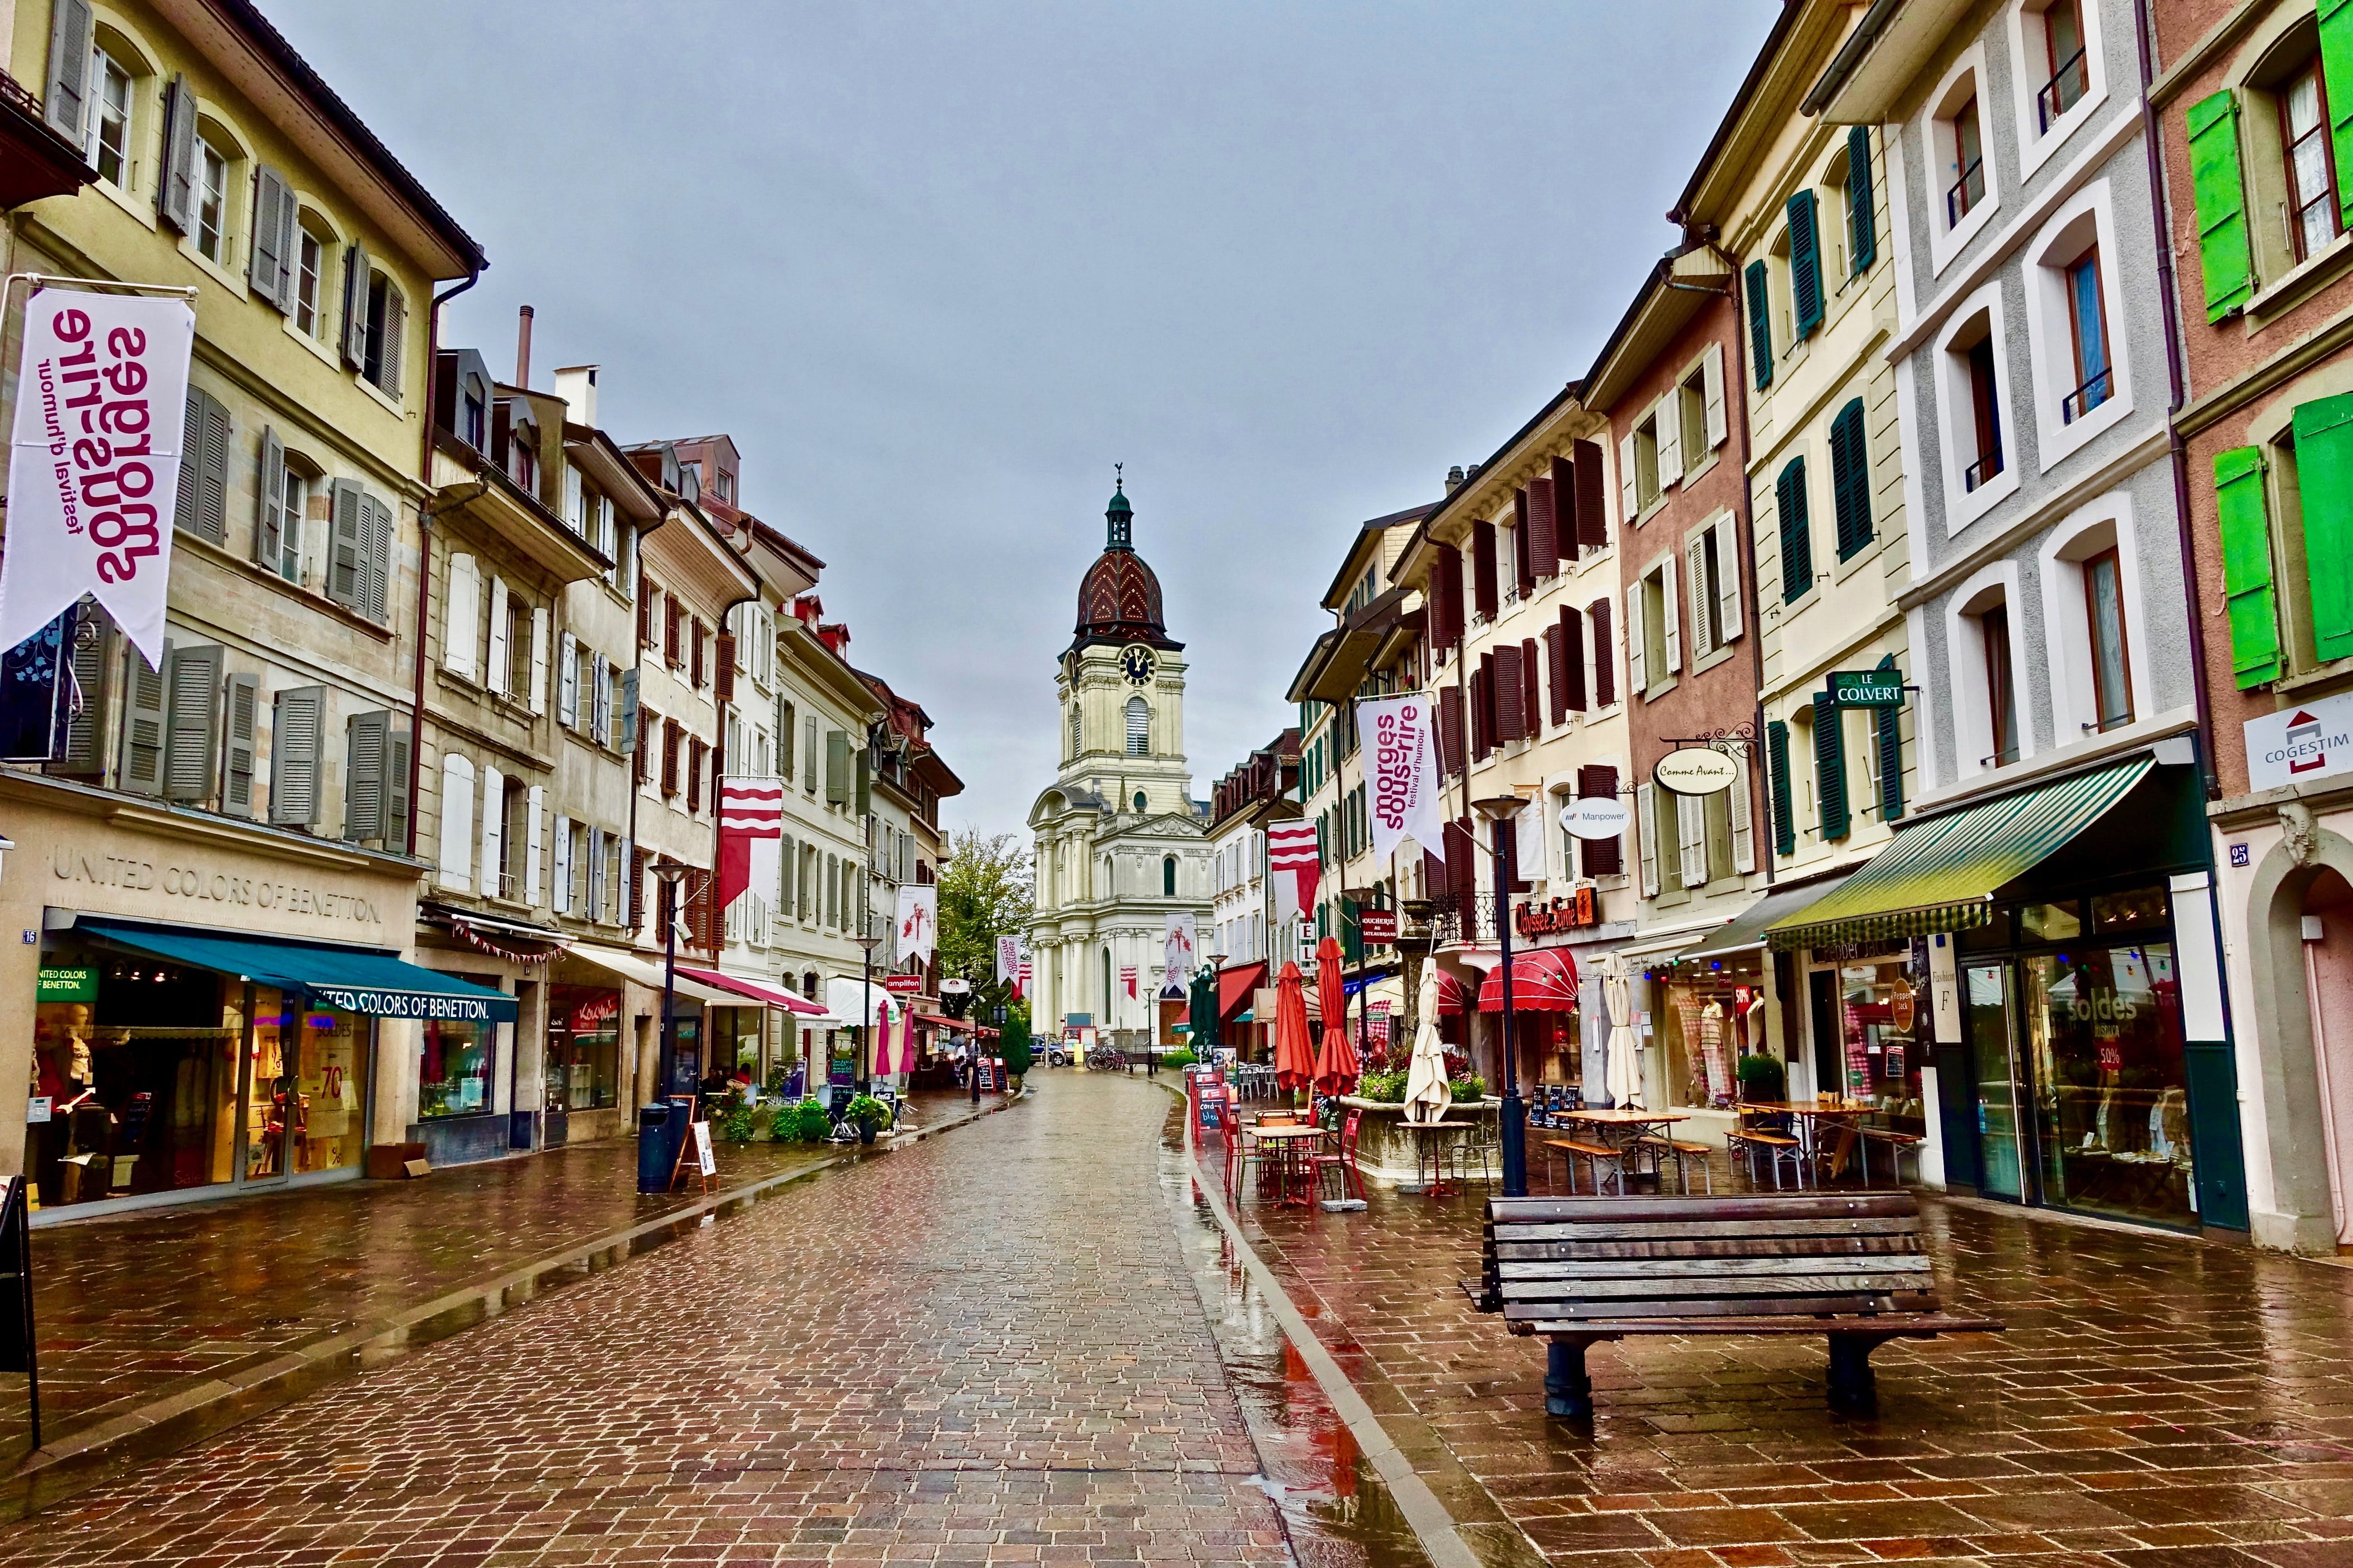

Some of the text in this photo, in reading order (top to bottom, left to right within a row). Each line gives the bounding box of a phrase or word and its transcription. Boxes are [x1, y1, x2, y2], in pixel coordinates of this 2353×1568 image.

[1862, 674, 1873, 684] LE
[1838, 687, 1900, 701] COLVERT
[2265, 732, 2350, 764] COGESTIM
[1386, 705, 1418, 830] sous-rire
[1408, 728, 1425, 808] festival d'humour
[1660, 765, 1694, 776] Comme
[1582, 813, 1625, 822] Manpower
[2231, 846, 2248, 865] 25
[53, 844, 155, 890] UNITED
[162, 867, 252, 905] COLORS
[257, 883, 284, 909] OF
[1550, 897, 1577, 931] Santé
[26, 931, 35, 942] 16
[39, 970, 86, 979] NITED COLORS
[887, 979, 919, 988] amplifon
[318, 990, 356, 1011] TED
[358, 993, 408, 1016] COLORS
[411, 997, 427, 1016] OF
[1735, 988, 1749, 1004] 50%
[1893, 991, 1912, 1000] Pepper
[1898, 1001, 1908, 1010] Jack
[2067, 987, 2137, 1022] soldes
[2100, 1047, 2120, 1064] 50%
[321, 1066, 343, 1099] 70
[1202, 1112, 1219, 1121] bleu
